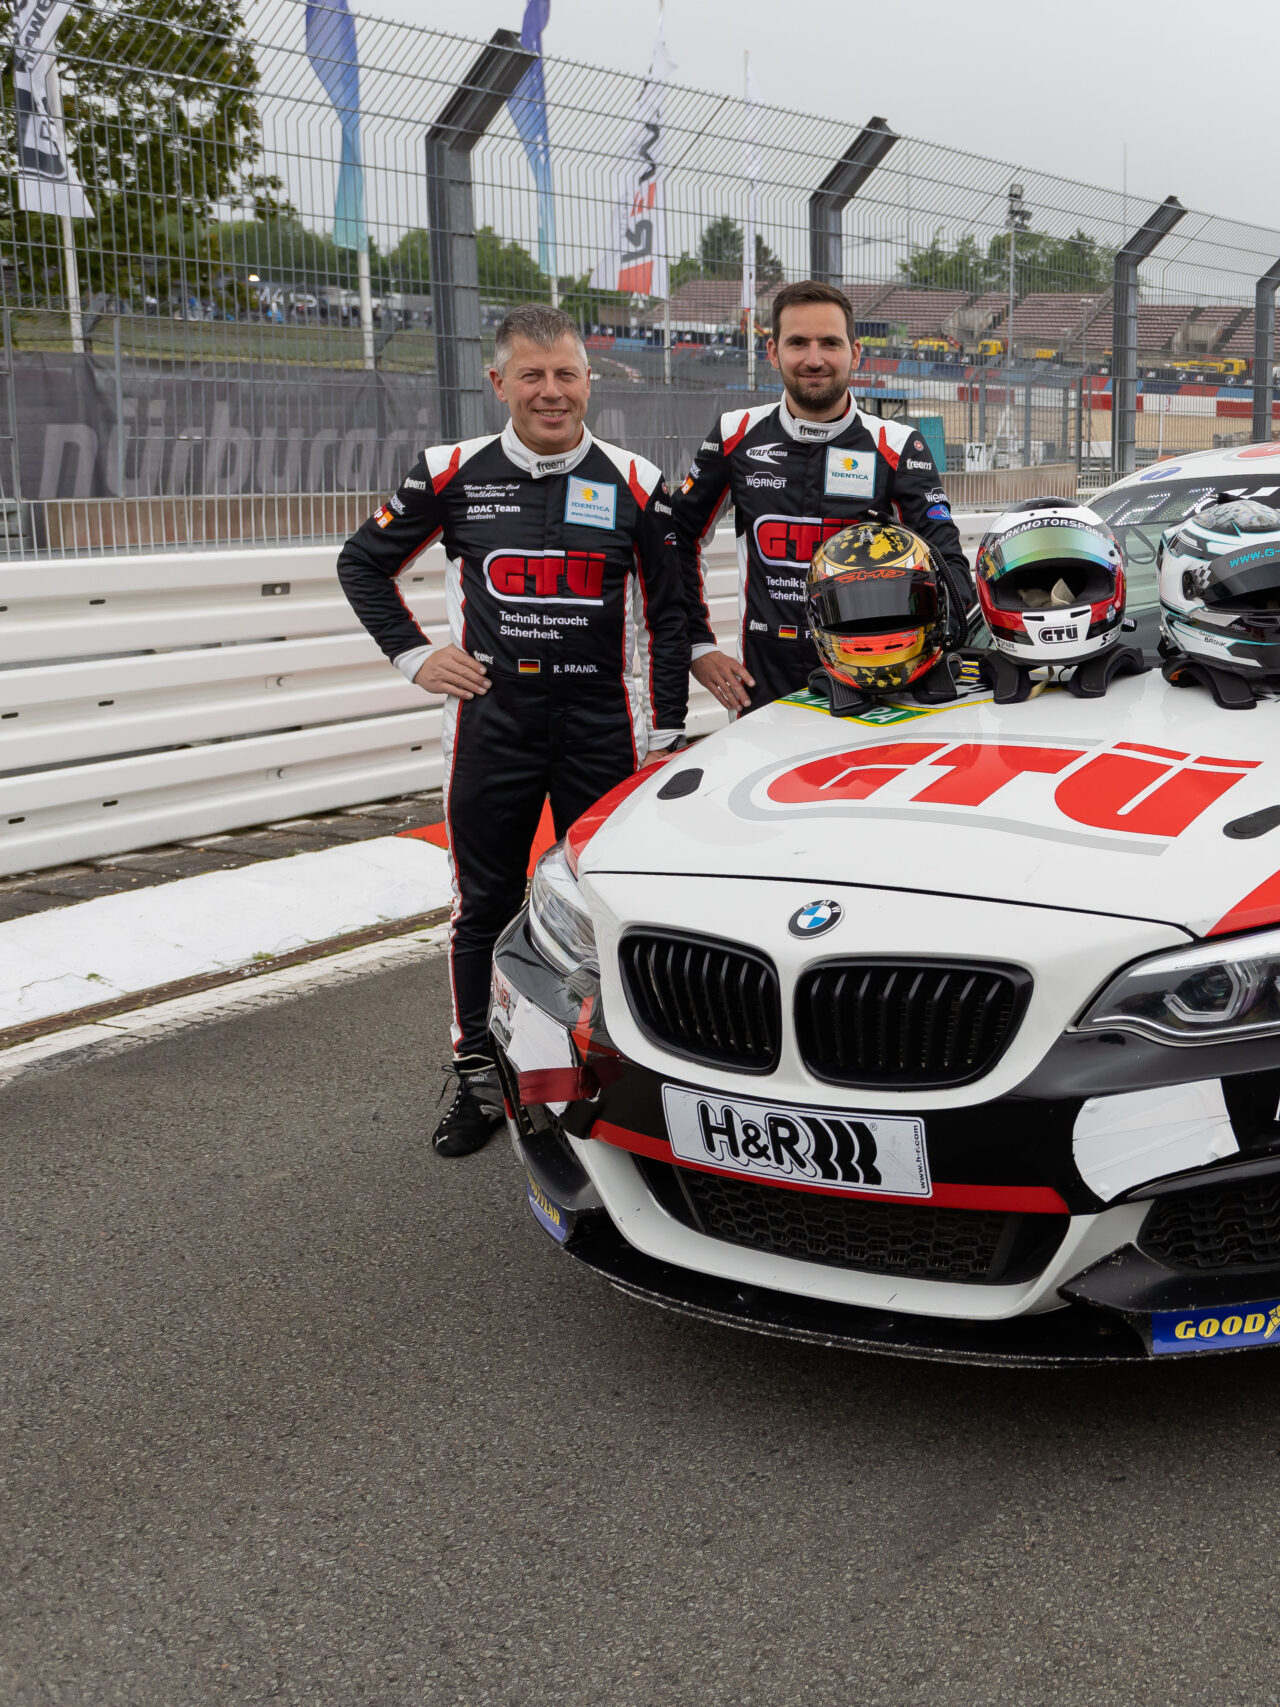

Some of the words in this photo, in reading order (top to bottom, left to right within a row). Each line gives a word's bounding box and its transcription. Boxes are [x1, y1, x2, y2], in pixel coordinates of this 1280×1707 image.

[799, 425, 830, 438] freem
[967, 445, 983, 463] 47
[535, 459, 567, 473] freem
[906, 458, 932, 471] freem
[831, 471, 869, 481] IDENTICA
[466, 505, 492, 514] ADAC
[494, 504, 521, 513] Team
[571, 501, 611, 513] IDENTICA
[488, 551, 606, 598] GTÜ
[766, 575, 799, 589] Technik
[500, 611, 541, 624] Technik
[543, 615, 589, 626] braucht
[500, 625, 563, 640] Sicherheit.
[1040, 624, 1079, 642] GTÜ
[553, 664, 563, 674] R.
[564, 664, 599, 674] BRANDL
[766, 741, 1264, 838] GTÜ
[698, 1100, 812, 1172] H&R
[913, 1124, 926, 1189] www.h-r.com
